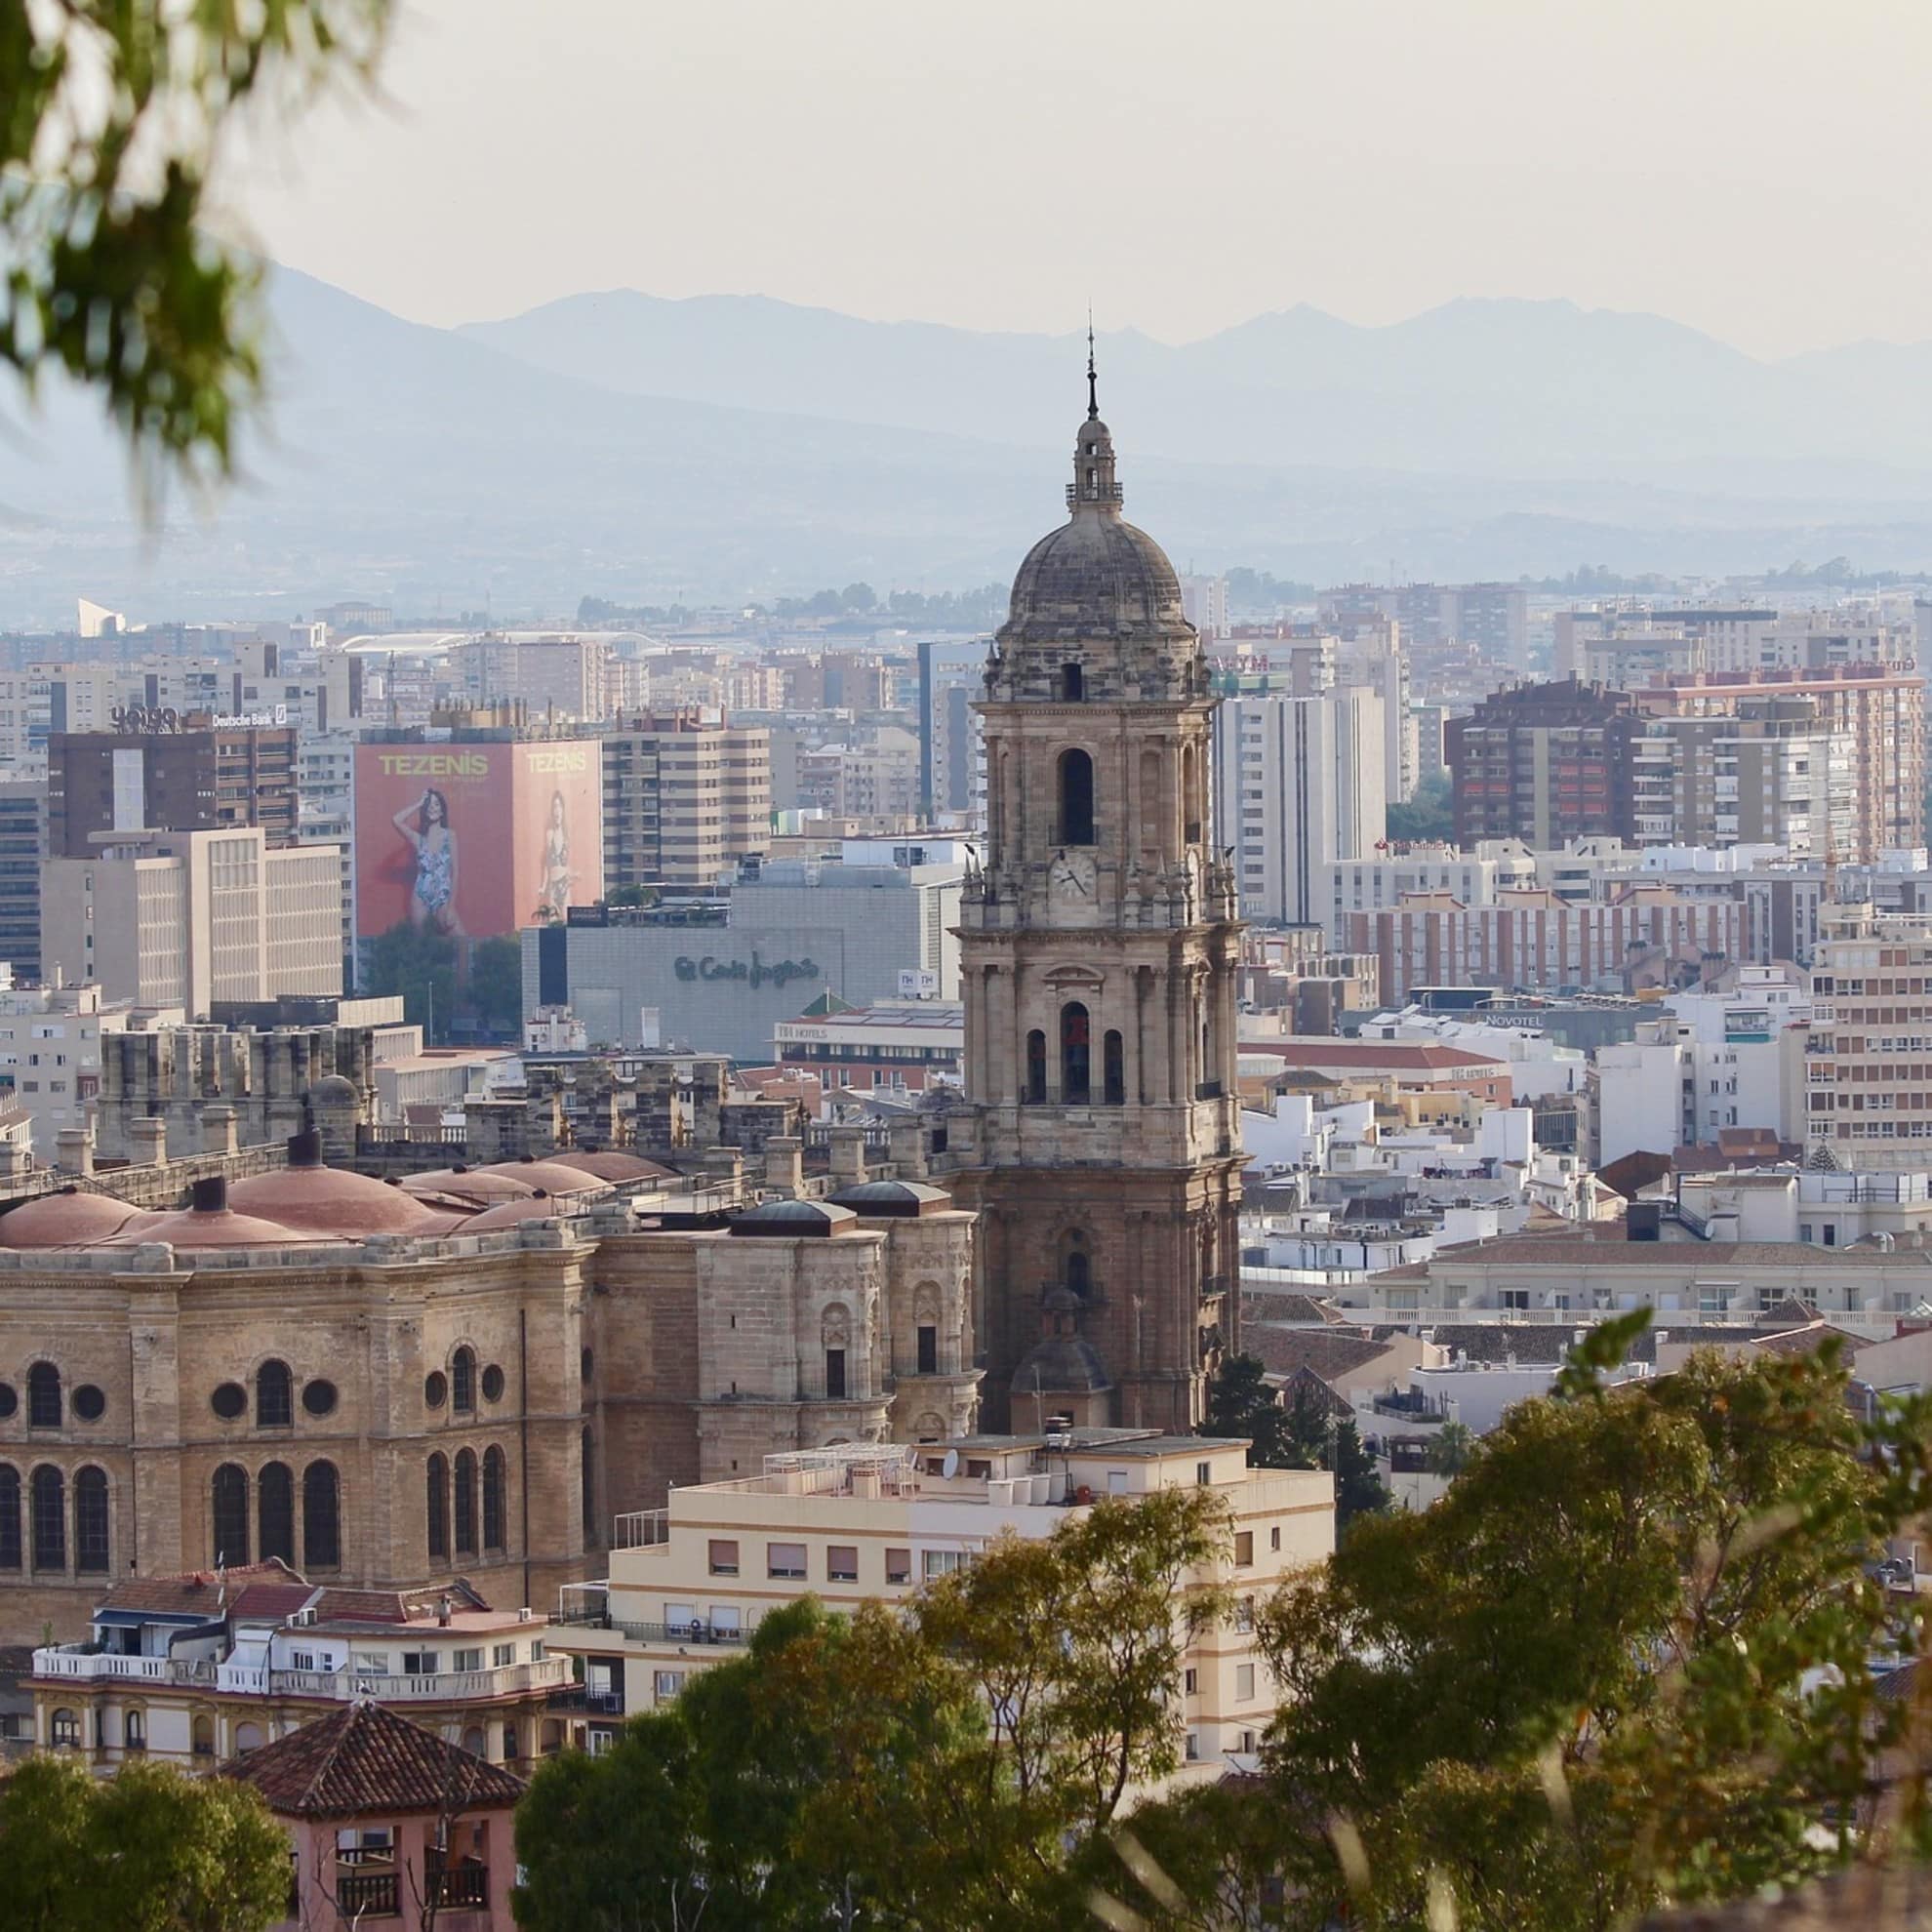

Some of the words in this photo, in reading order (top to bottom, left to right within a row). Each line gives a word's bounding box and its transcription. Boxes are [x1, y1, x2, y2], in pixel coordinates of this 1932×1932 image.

[213, 714, 251, 727] Deutsche
[252, 713, 272, 726] Bank
[1485, 1016, 1544, 1027] NOVOTEL
[795, 1030, 827, 1039] HOTELS
